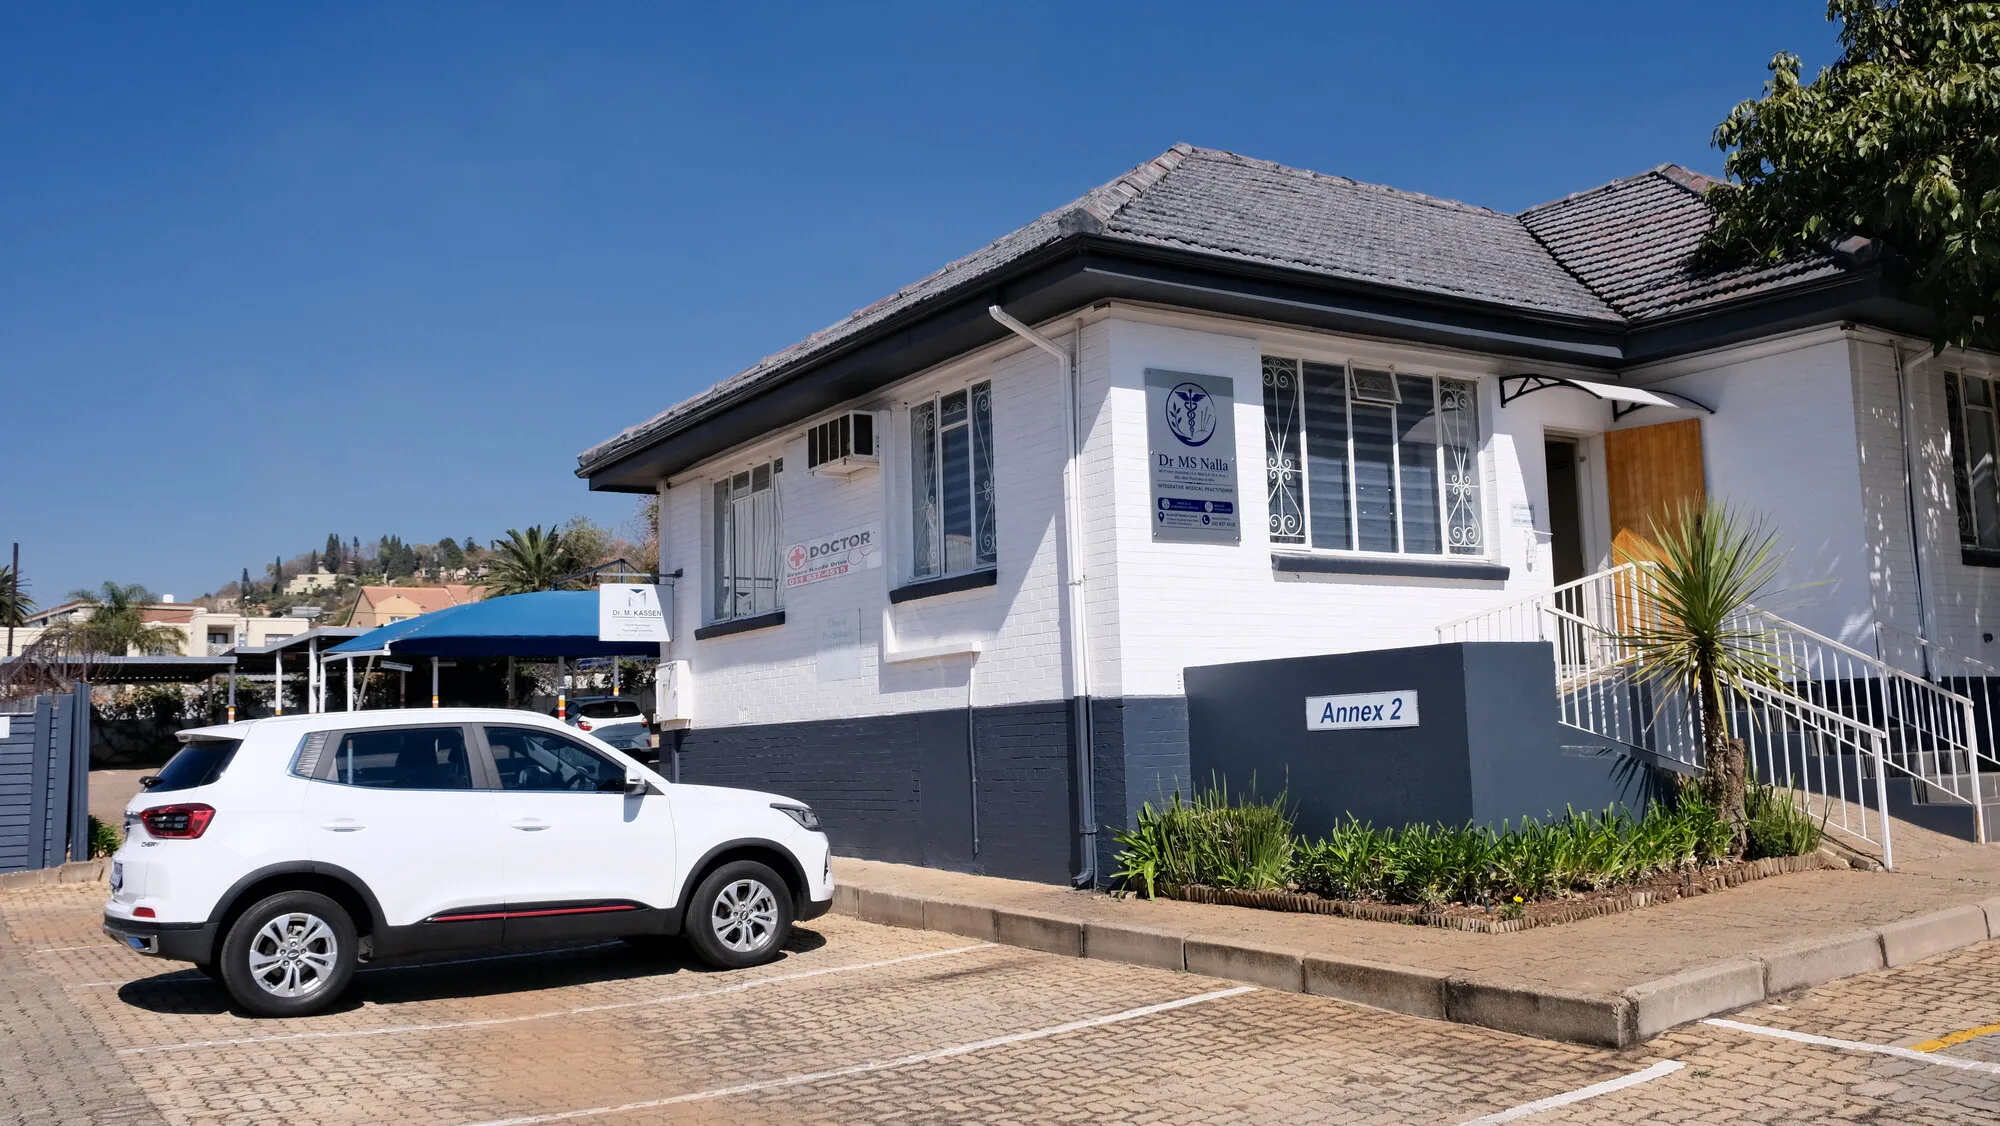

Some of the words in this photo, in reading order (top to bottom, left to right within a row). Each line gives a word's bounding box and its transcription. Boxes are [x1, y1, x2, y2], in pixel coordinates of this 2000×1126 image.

[1158, 454, 1174, 467] Dr
[1178, 456, 1197, 469] MS
[1200, 457, 1229, 471] Nalla
[1157, 483, 1185, 491] INTEGRATIVE
[809, 531, 870, 558] DOCTOR
[830, 559, 848, 568] Drive
[788, 576, 804, 585] 011
[633, 609, 662, 617] KASSEN
[1320, 701, 1385, 724] Annex
[1389, 697, 1403, 720] 2
